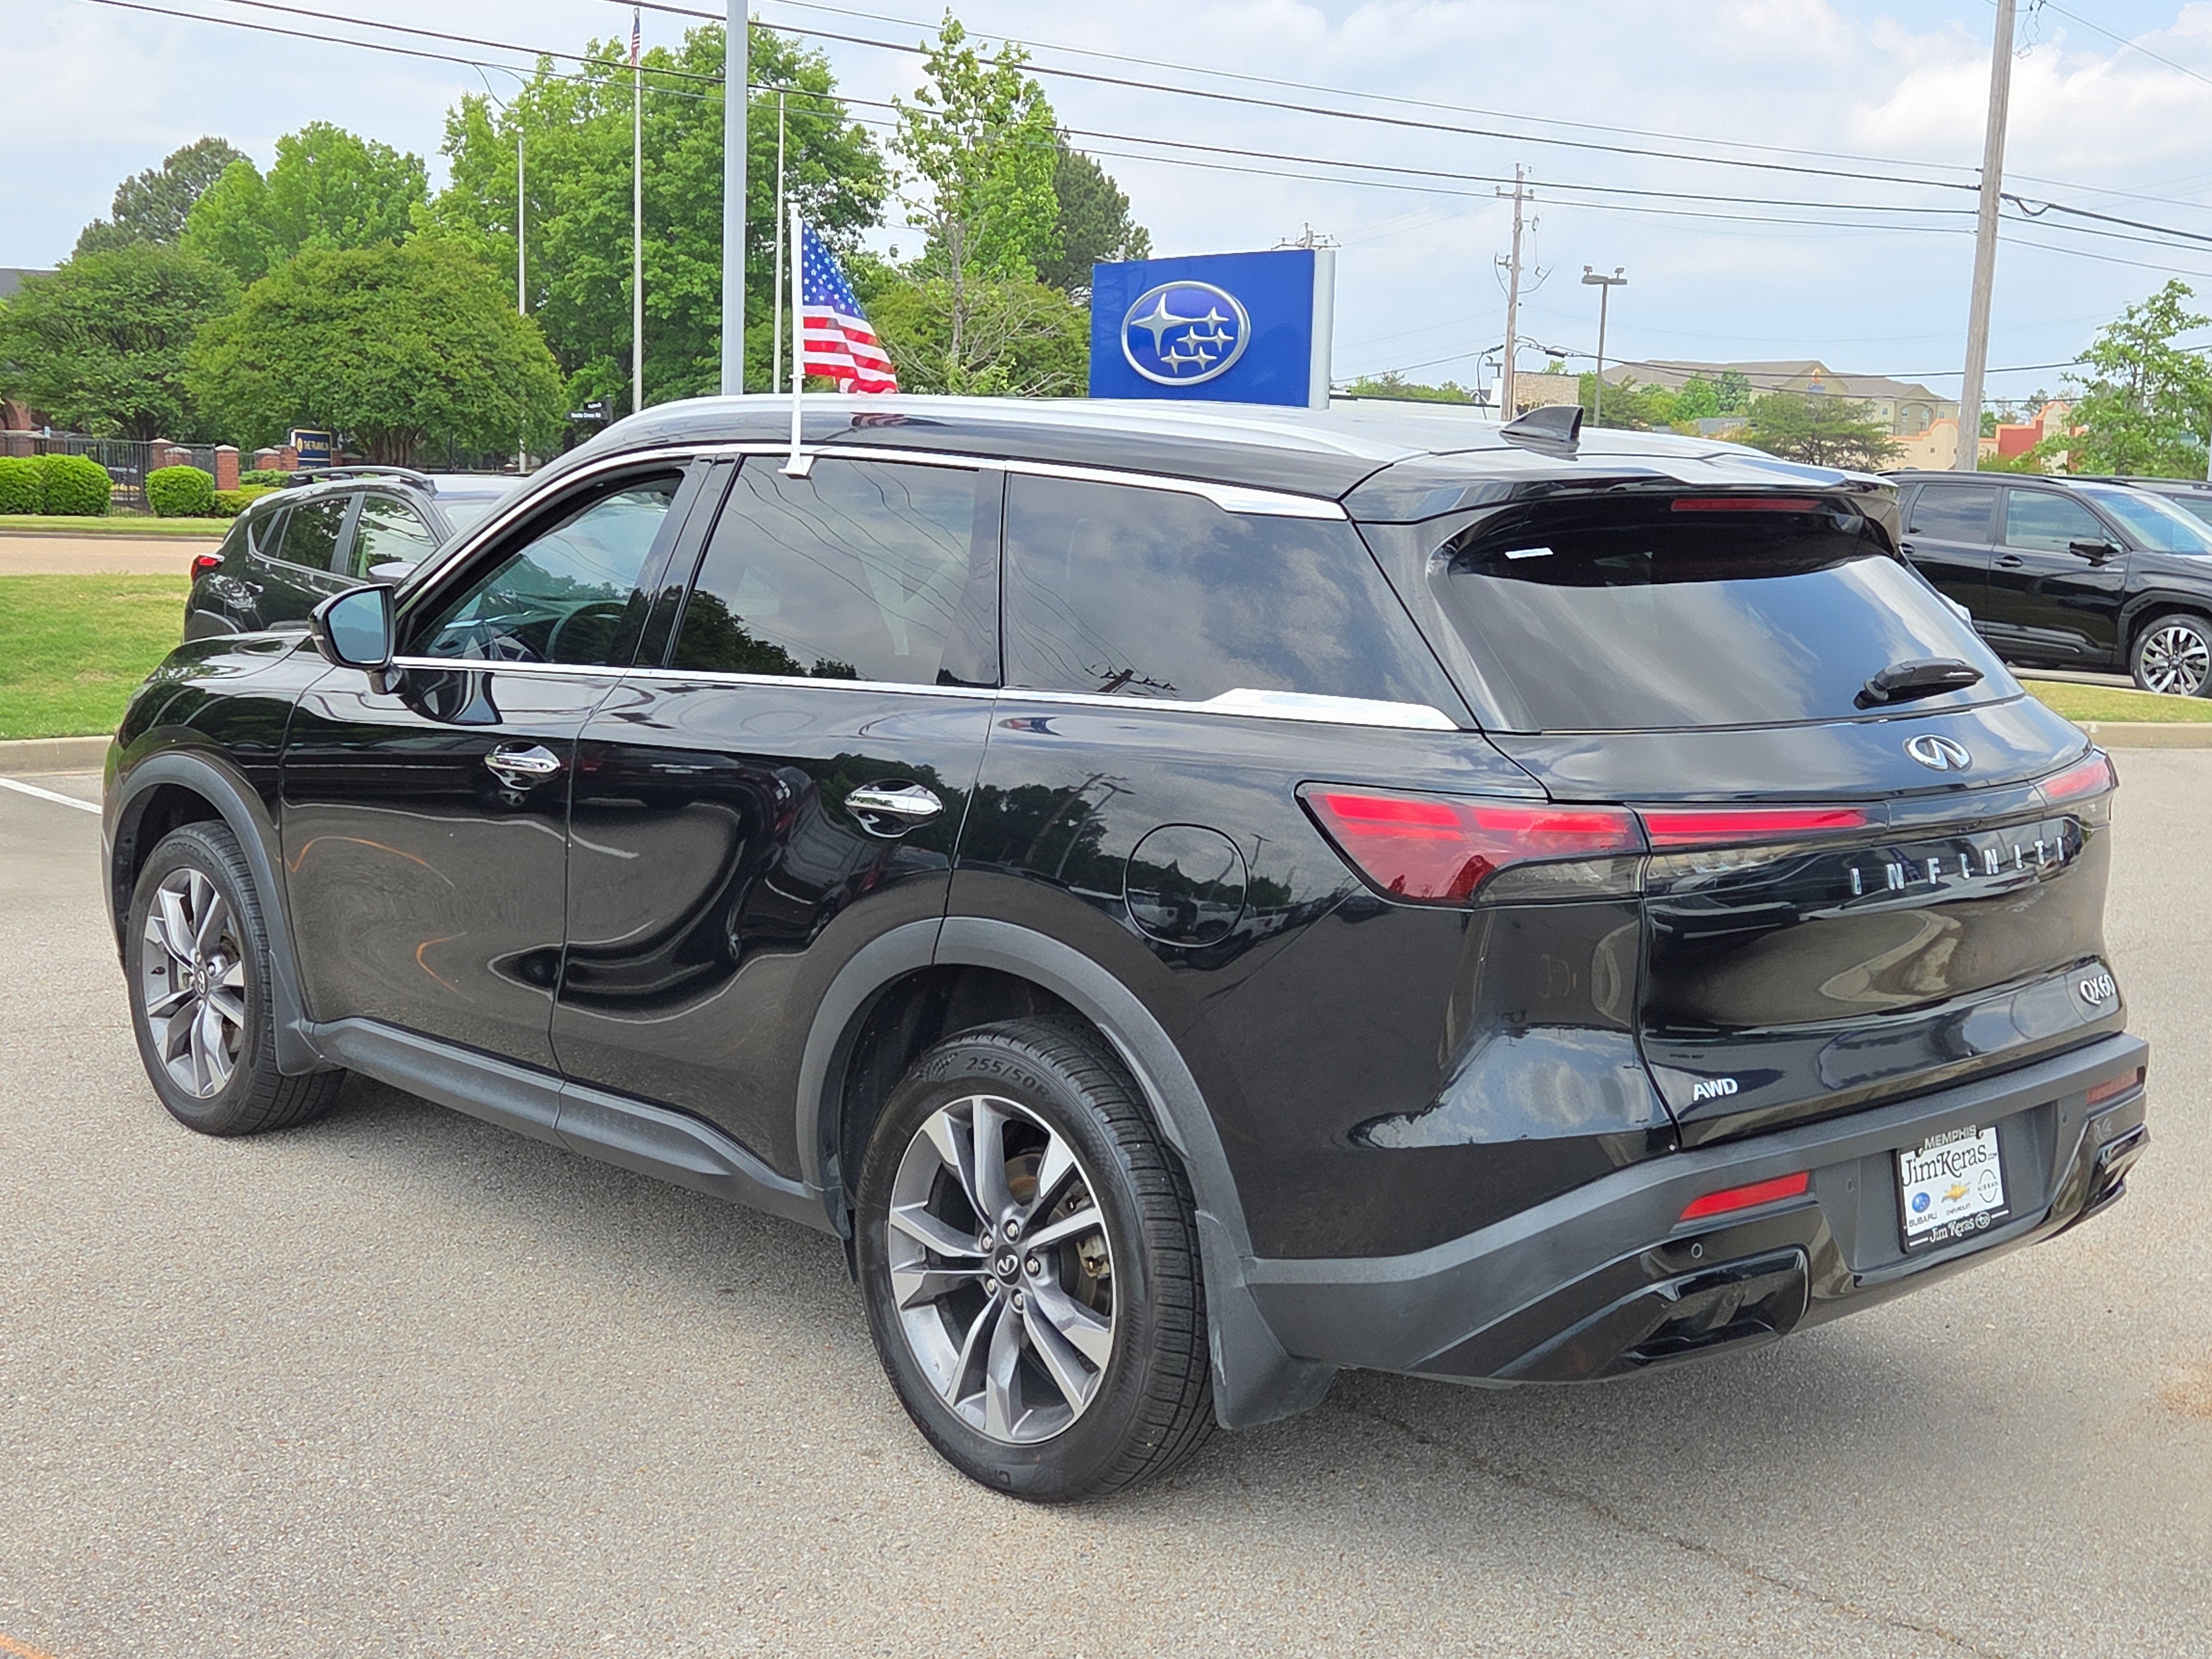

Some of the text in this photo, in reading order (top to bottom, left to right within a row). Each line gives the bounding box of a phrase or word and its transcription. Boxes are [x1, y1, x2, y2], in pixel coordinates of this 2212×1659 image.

[1850, 837, 2064, 895] INFINITI
[2080, 974, 2116, 1005] QX60
[1693, 1078, 1738, 1101] AWD
[1925, 1124, 1977, 1150] MEMPHIS
[1908, 1211, 1937, 1227] SUBARU
[1929, 1218, 1975, 1243] Jim Keras
